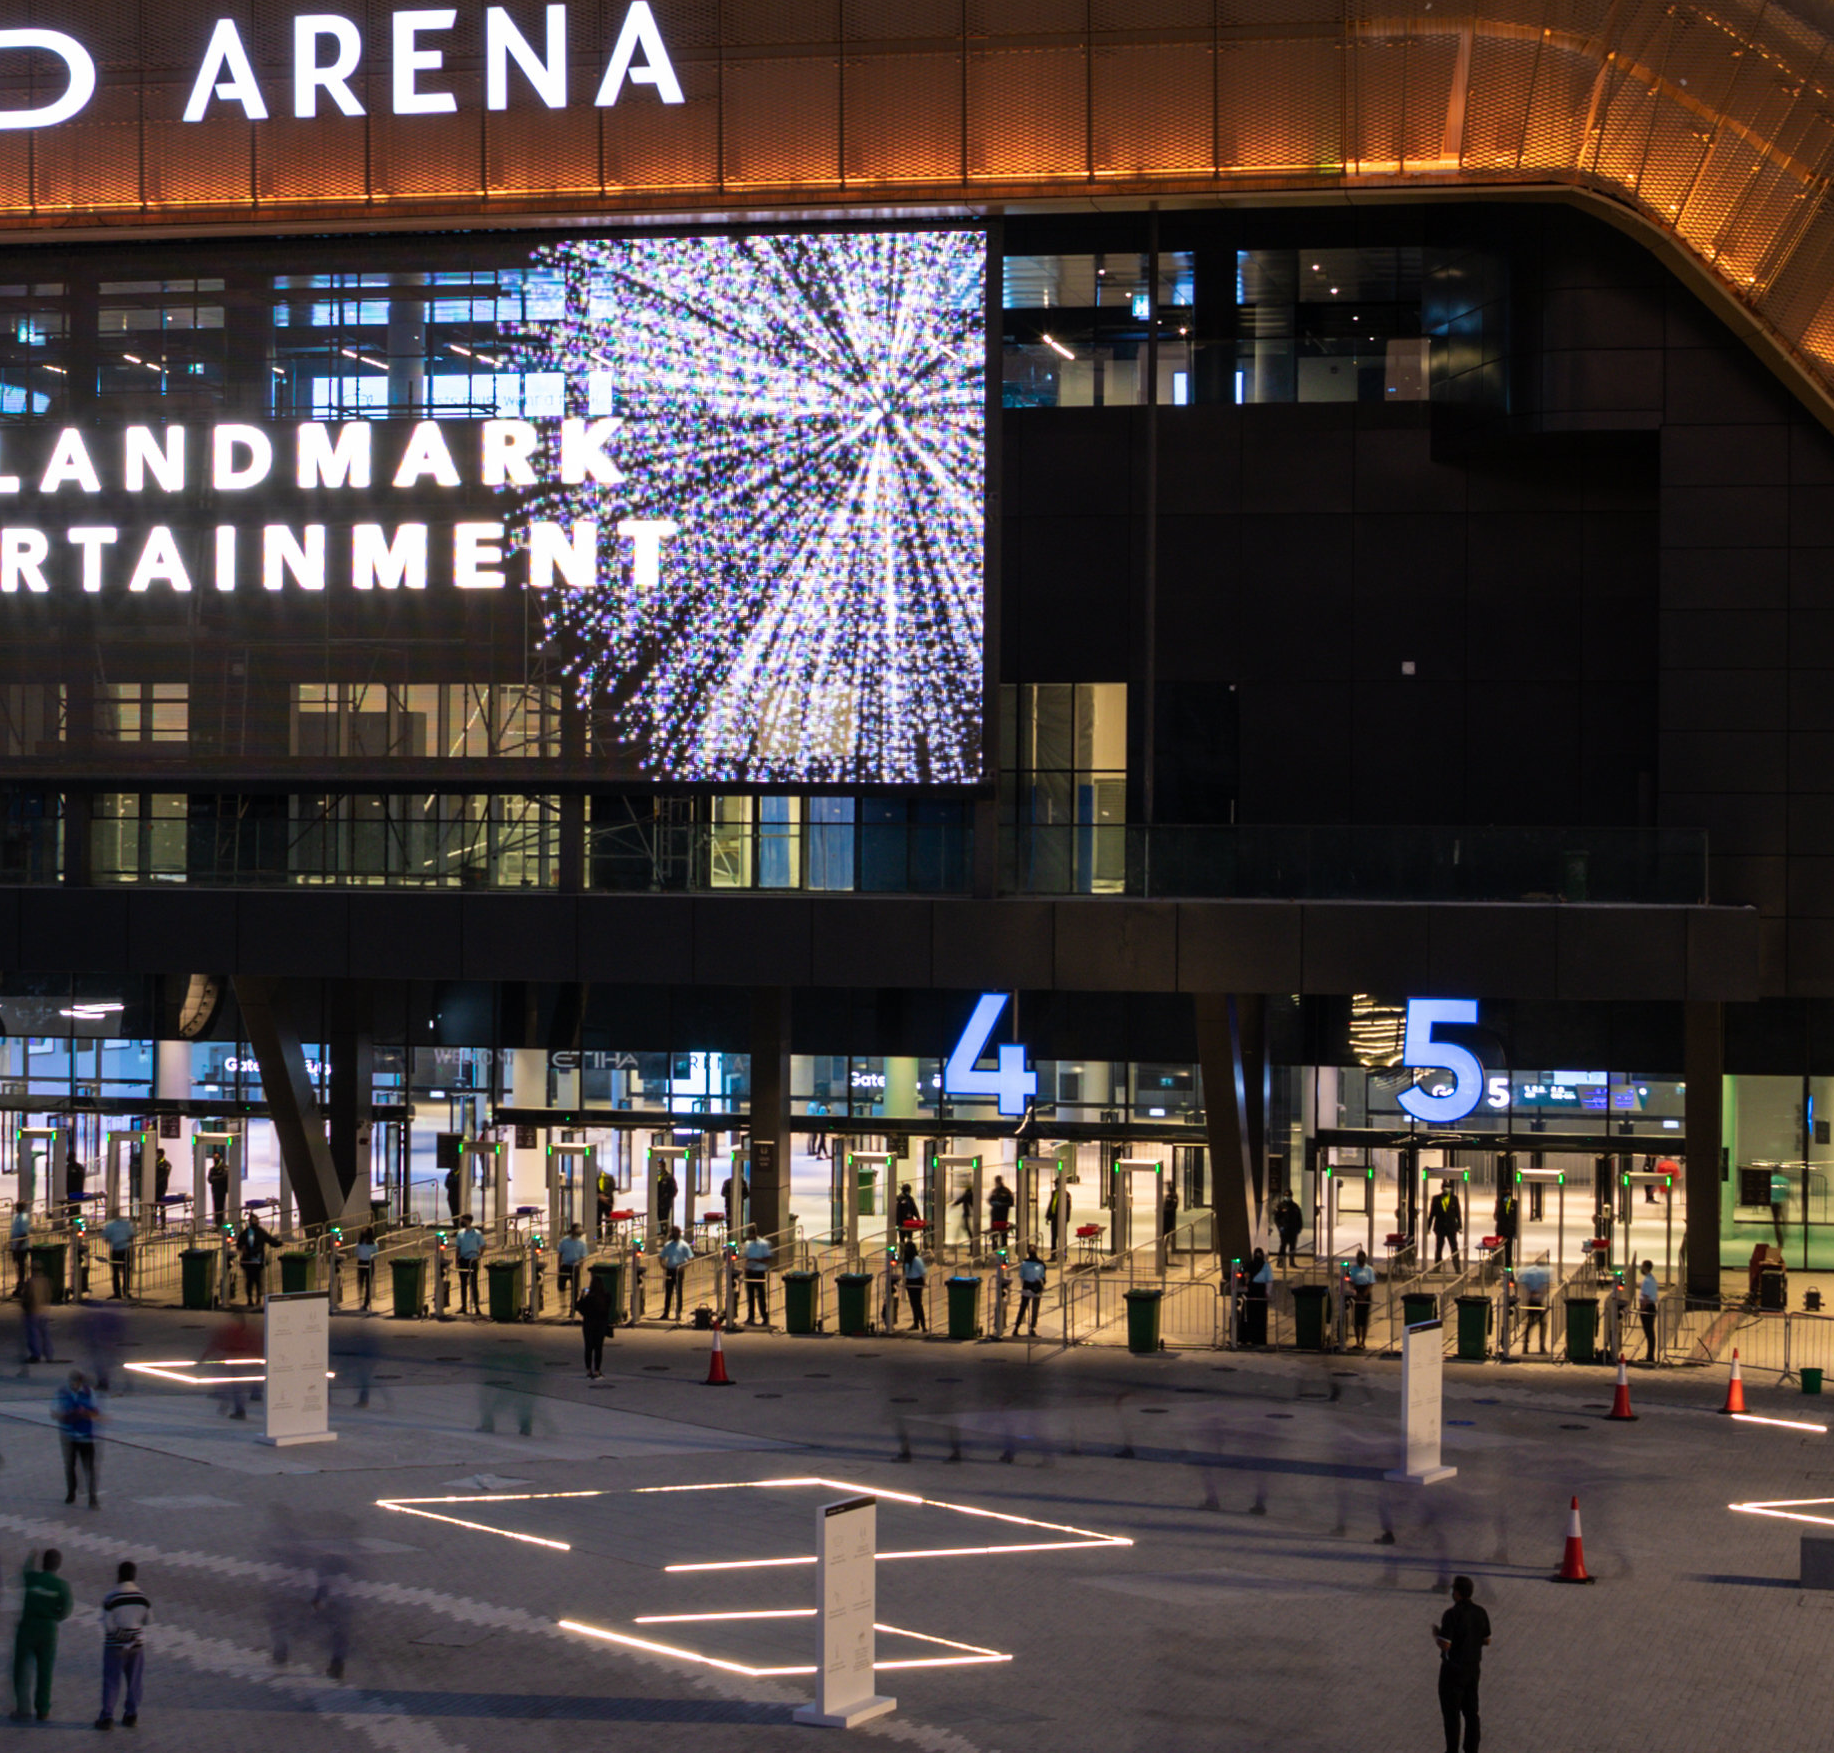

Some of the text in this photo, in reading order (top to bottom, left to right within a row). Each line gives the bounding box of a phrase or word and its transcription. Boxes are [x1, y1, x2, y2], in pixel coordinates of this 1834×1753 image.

[182, 0, 686, 123] ARENA
[551, 1050, 639, 1068] ETIHA
[944, 993, 1038, 1115] 4
[1397, 998, 1483, 1123] 5
[1487, 1077, 1511, 1108] 5
